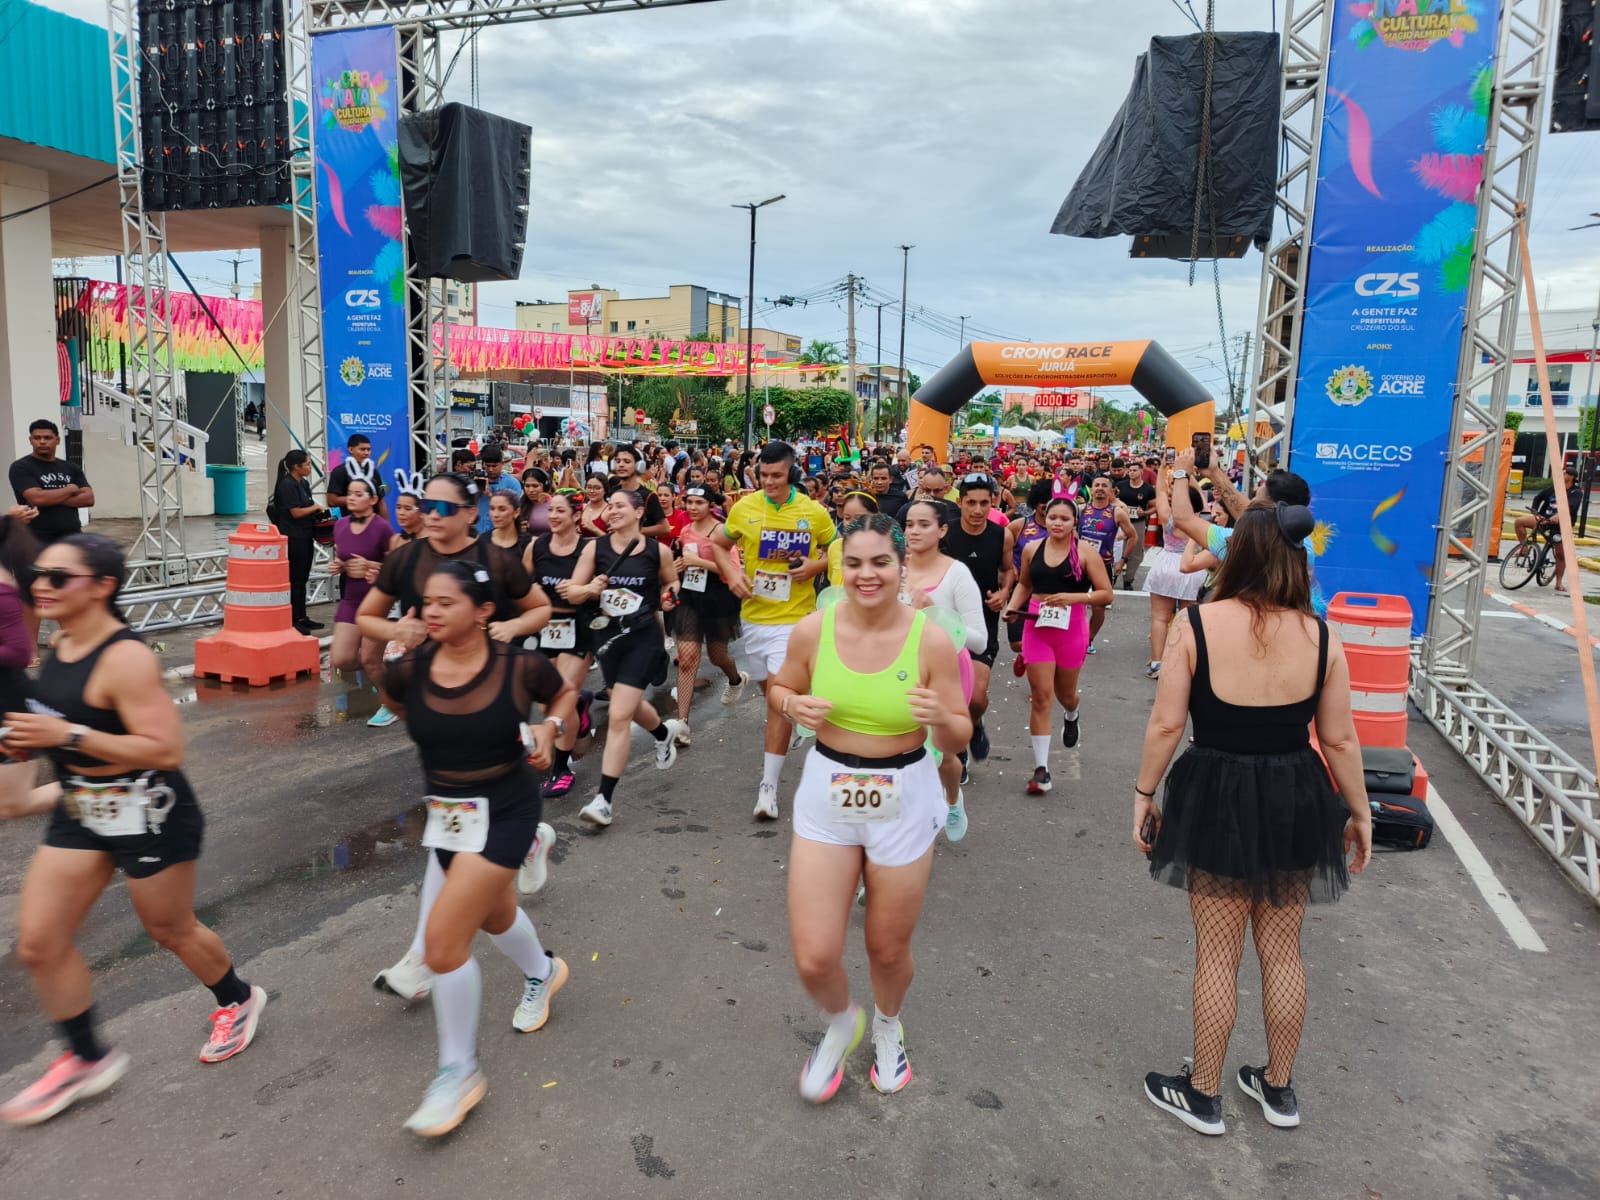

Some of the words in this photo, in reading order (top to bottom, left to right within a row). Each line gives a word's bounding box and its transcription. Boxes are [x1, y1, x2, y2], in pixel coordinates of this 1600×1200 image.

[1380, 14, 1457, 32] CULTURAL
[341, 70, 371, 89] CAR
[333, 87, 378, 110] NAVAL
[1355, 273, 1420, 297] CZS
[345, 289, 381, 307] CZS
[1352, 308, 1359, 316] A
[1361, 308, 1396, 316] GENTE
[1398, 307, 1418, 316] FAZ
[368, 367, 392, 378] ACRE
[1038, 360, 1075, 372] JURUÁ
[1378, 380, 1425, 394] ACRE
[354, 413, 392, 426] ACECS
[1337, 444, 1413, 462] ACECS
[761, 530, 776, 541] DE
[777, 531, 811, 544] OLHO
[610, 576, 646, 585] SWAT
[764, 580, 776, 591] 23
[606, 594, 628, 610] 168
[1042, 609, 1060, 619] 251
[841, 788, 881, 808] 200
